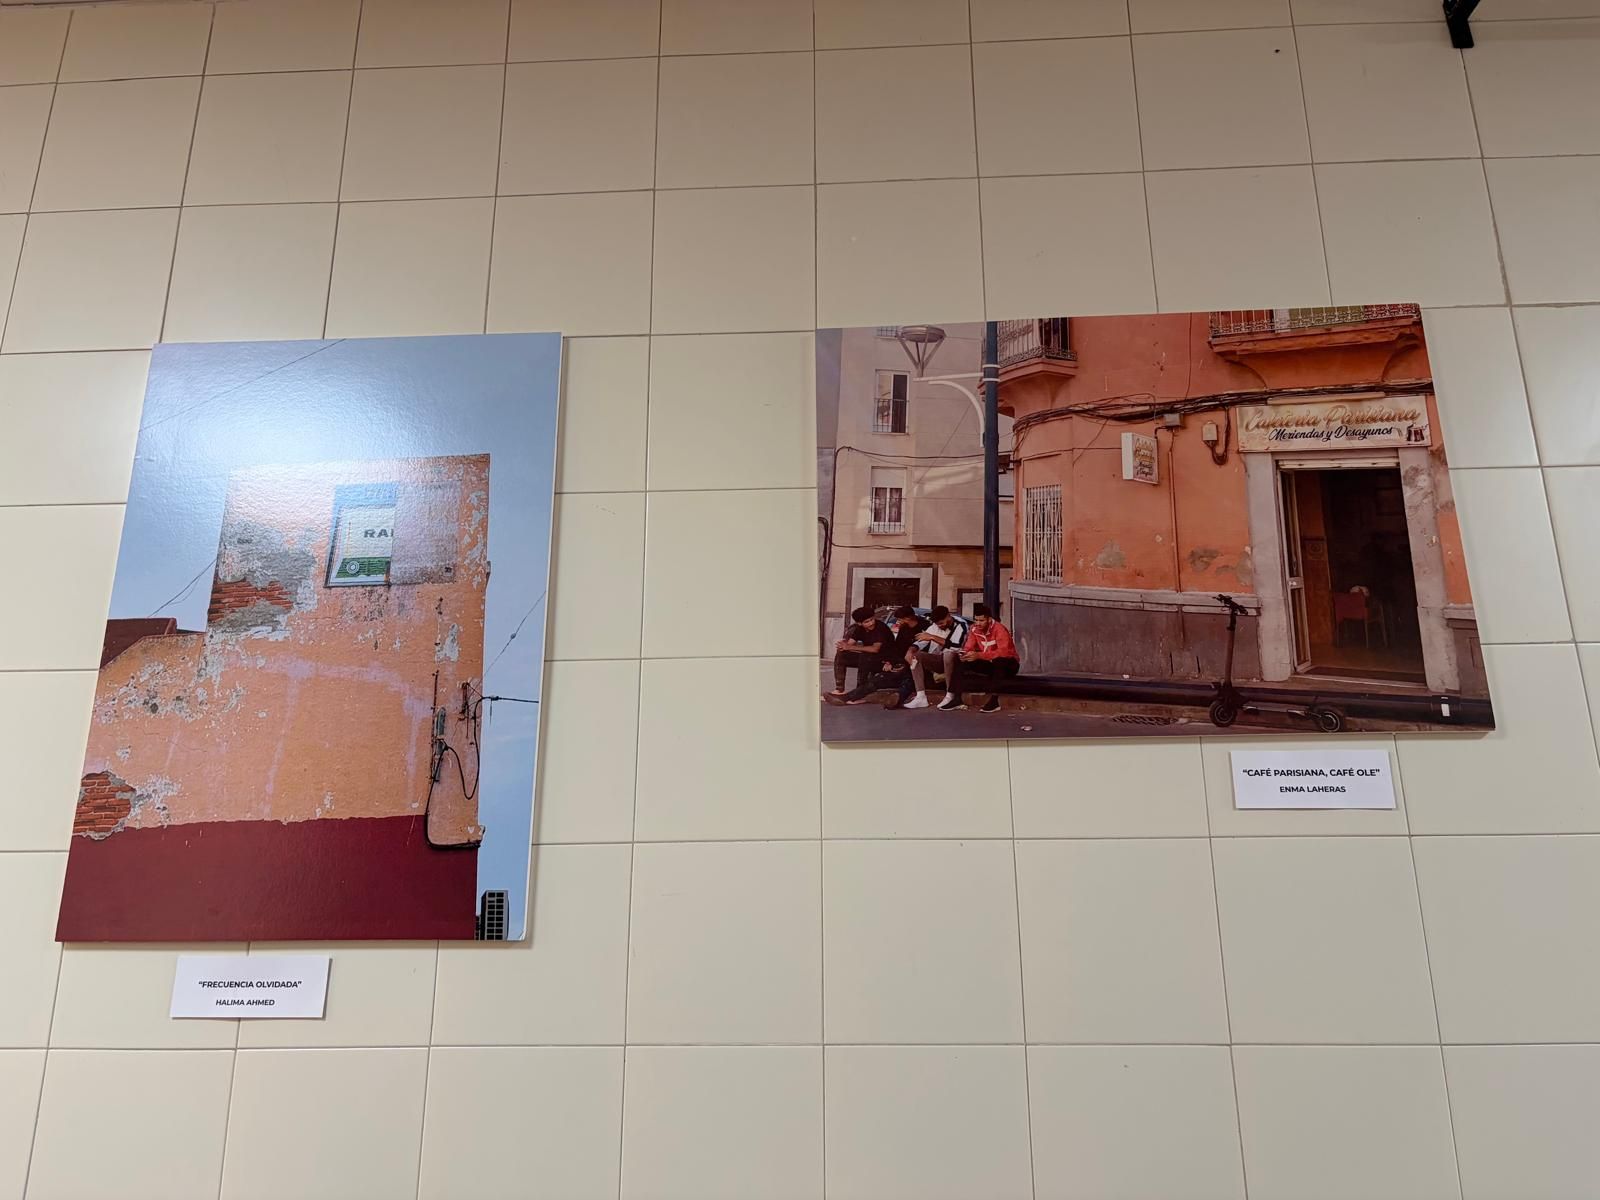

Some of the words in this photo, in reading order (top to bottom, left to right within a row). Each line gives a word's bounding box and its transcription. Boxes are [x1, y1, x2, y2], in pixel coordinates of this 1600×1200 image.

[1323, 404, 1420, 428] Parisiana
[1269, 428, 1325, 442] Meriendas
[1324, 430, 1334, 442] y
[1334, 424, 1393, 441] Desayunos
[1273, 768, 1329, 778] PARISIANA,
[1329, 767, 1355, 777] CAFÉ
[1279, 785, 1306, 793] ENMA
[1306, 785, 1347, 793] LAHERAS
